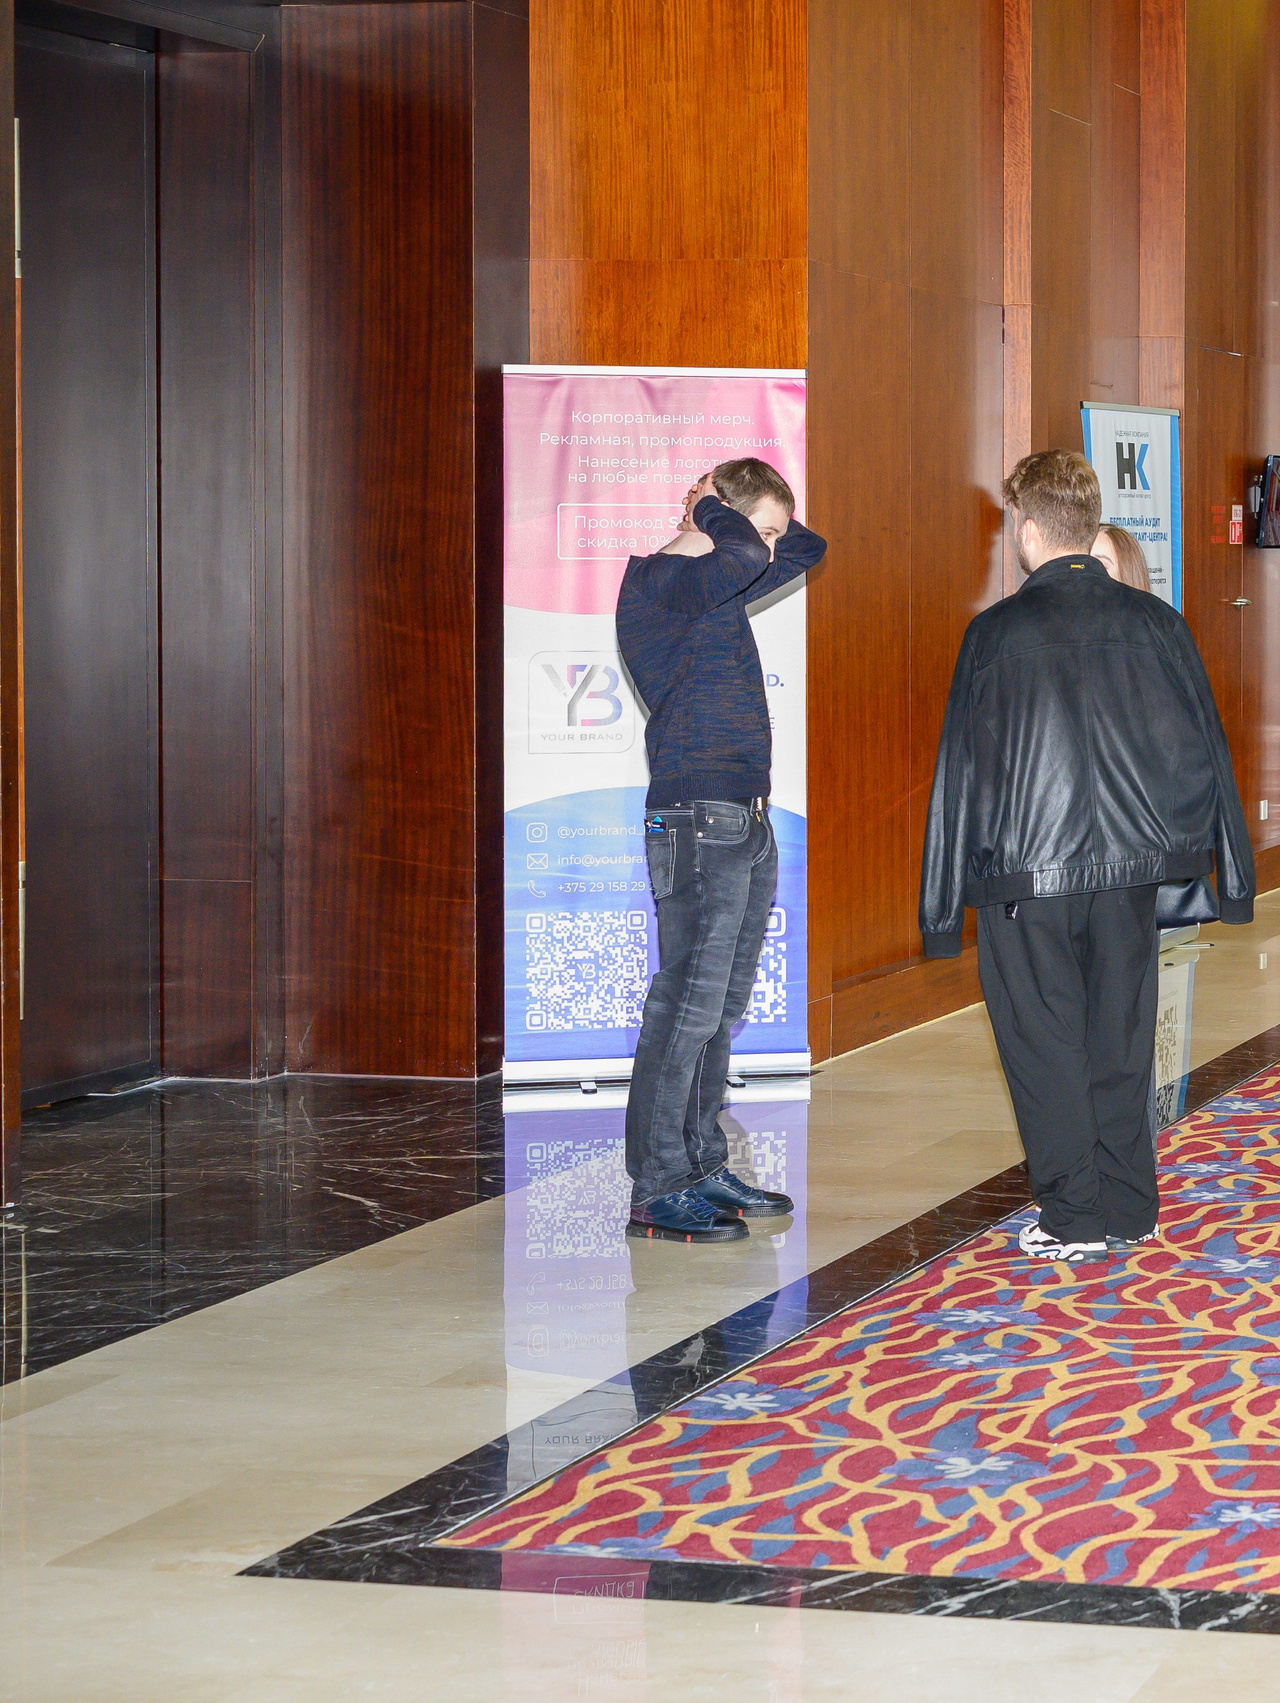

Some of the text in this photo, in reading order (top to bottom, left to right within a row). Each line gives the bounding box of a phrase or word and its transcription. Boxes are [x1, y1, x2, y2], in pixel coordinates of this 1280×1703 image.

[571, 410, 755, 427] Корпоративный мерч.
[540, 432, 785, 450] Рекламная, промопродукция.
[578, 455, 670, 468] Нанесение
[568, 470, 701, 485] на любые повер
[574, 515, 664, 531] Промокод
[1145, 518, 1160, 527] АУДИТ
[577, 535, 672, 549] скидка 10%
[541, 733, 623, 741] YOUR BRAND
[557, 825, 645, 839] @yourbrand_
[558, 881, 586, 893] +375
[589, 881, 604, 893] 29
[607, 881, 628, 892] 158
[631, 881, 645, 892] 29
